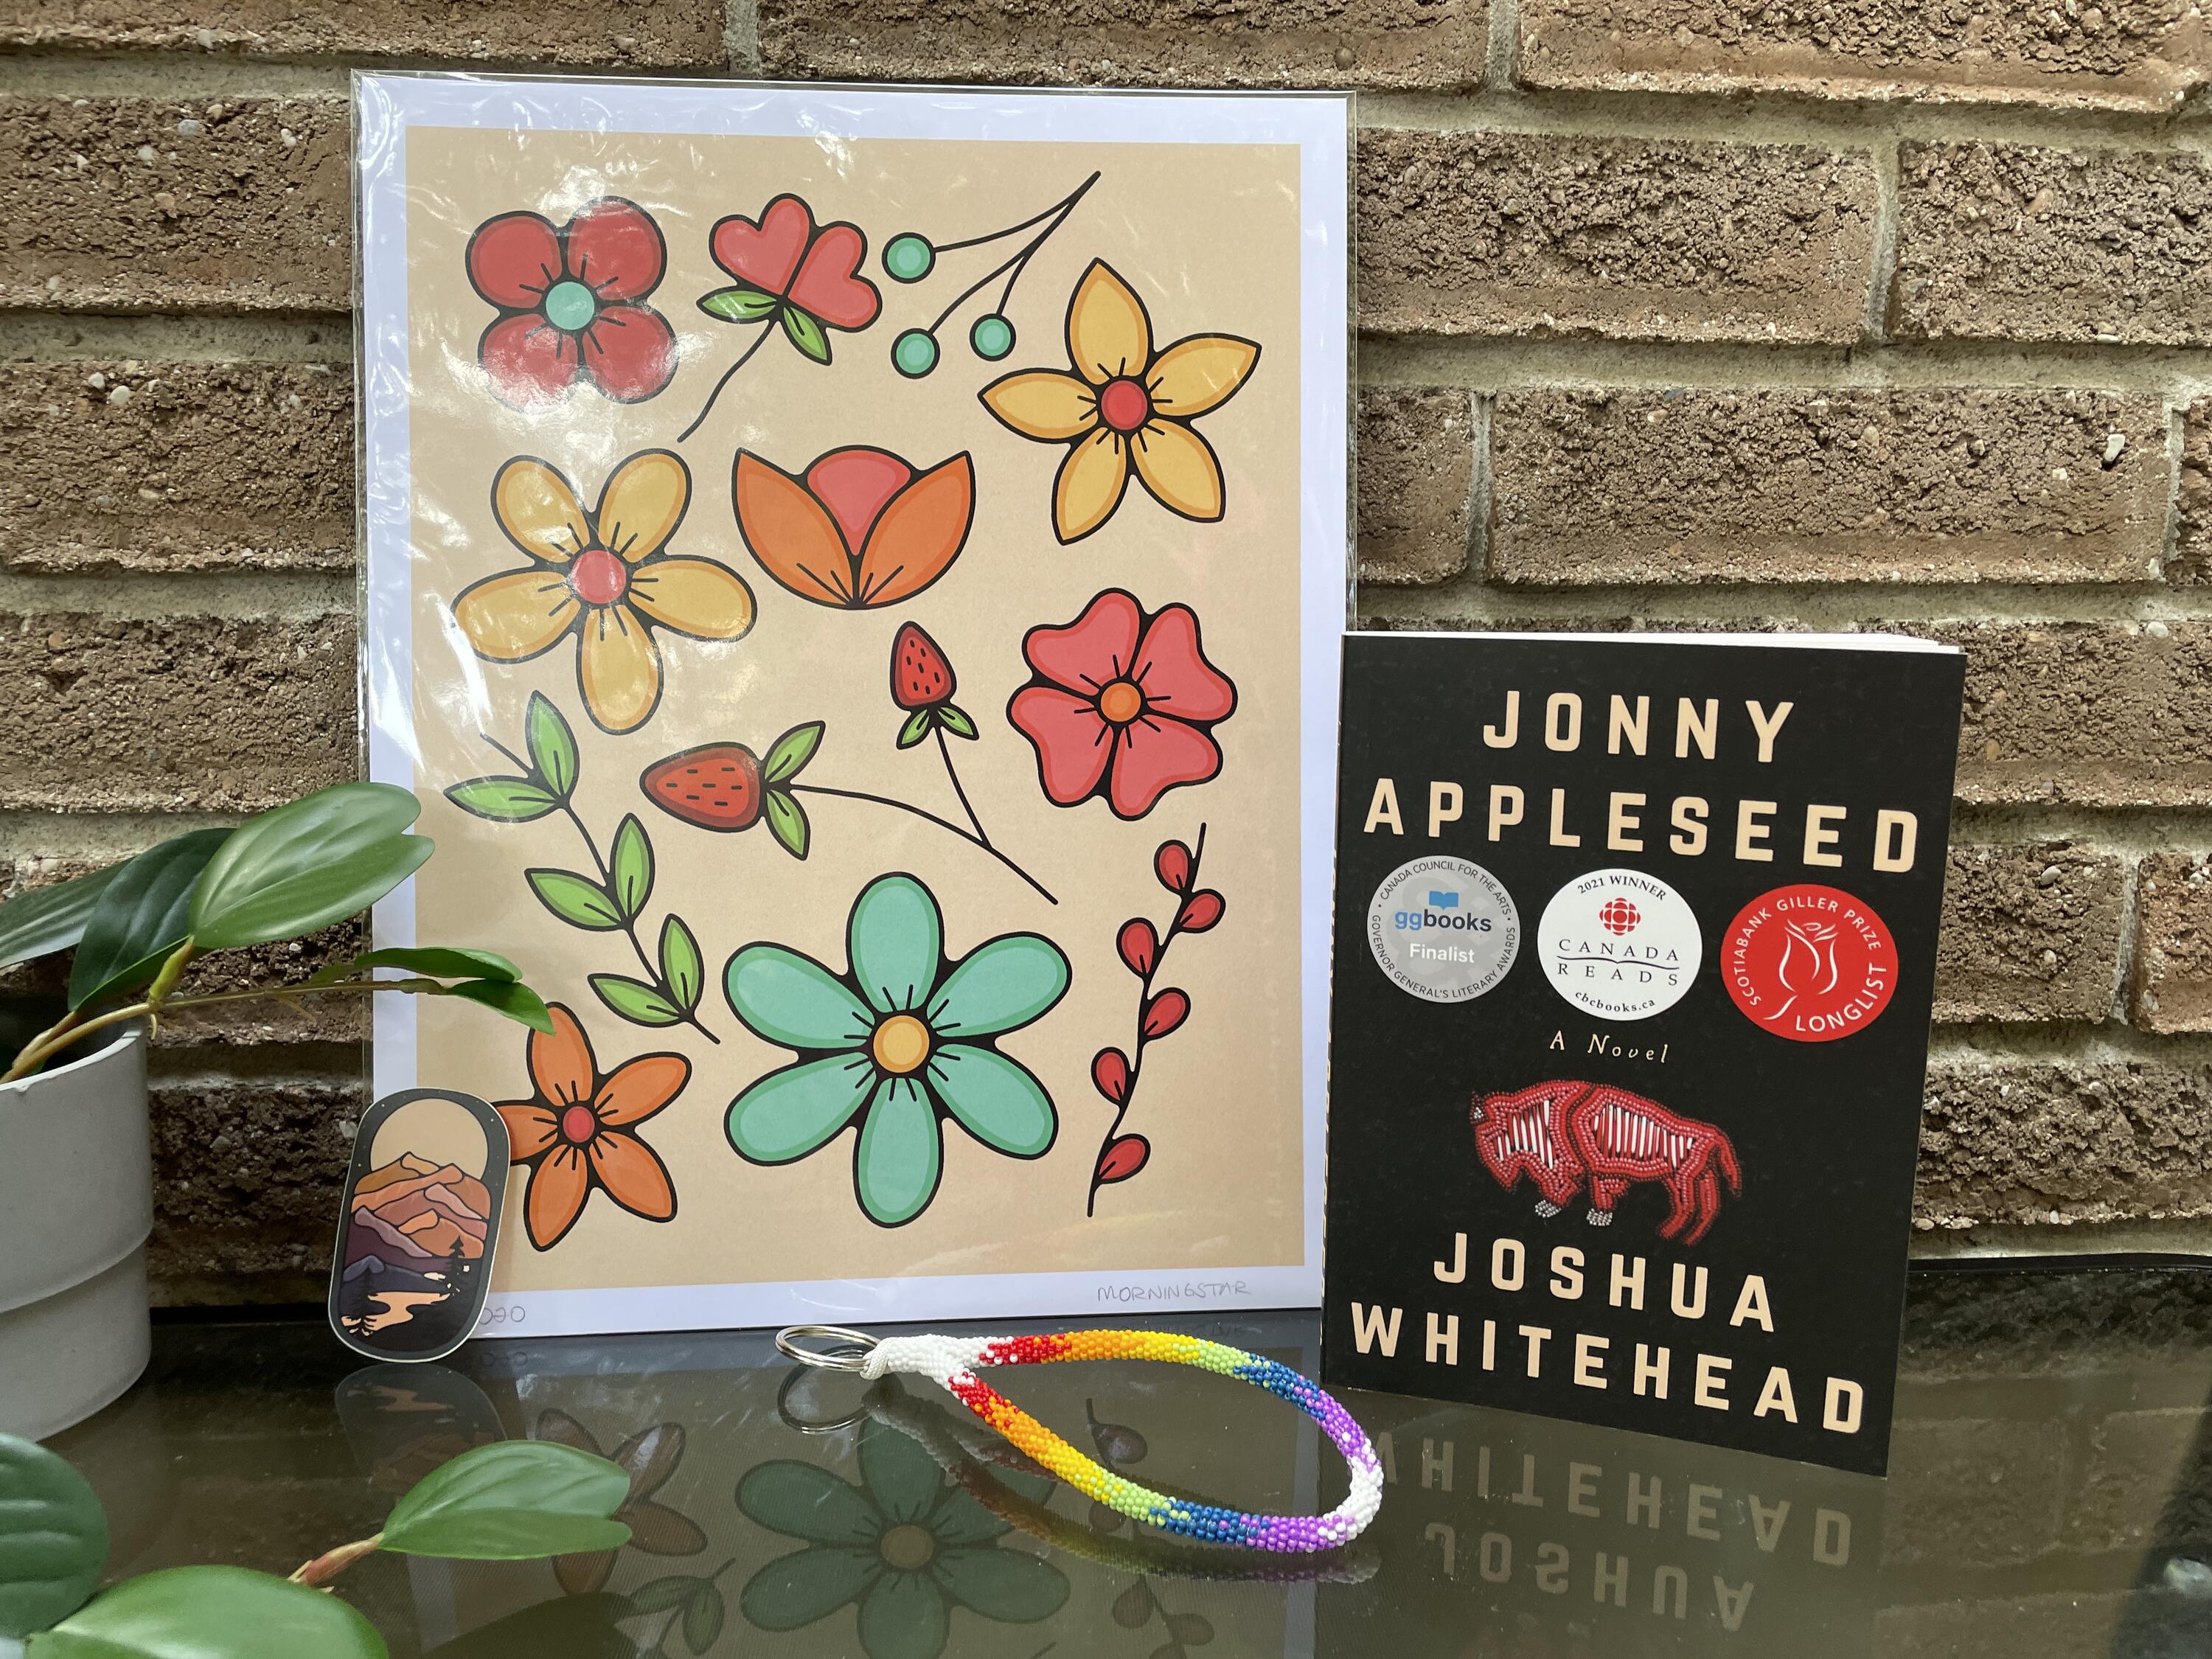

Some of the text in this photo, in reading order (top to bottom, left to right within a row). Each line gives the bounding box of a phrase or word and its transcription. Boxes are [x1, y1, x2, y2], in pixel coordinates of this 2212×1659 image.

[1483, 690, 1794, 763] JONNY
[1363, 777, 1918, 873] APPLESEED
[1380, 860, 1512, 916] CANADA COUNCIL FOR THE ARTS
[1577, 875, 1667, 901] 2021 WINNER
[1394, 908, 1492, 932] ggbooks
[1371, 914, 1515, 998] GOVERNOR GENERAL'S LITERARY AWARDS
[1409, 942, 1475, 964] Finalist
[1559, 939, 1679, 961] CANADA
[1733, 896, 1882, 1006] SCOTIABANK GILLER PRIZE
[1557, 962, 1678, 986] READS
[1575, 991, 1655, 1012] cbcbooks.ca
[1795, 961, 1888, 1032] LONGLIST
[1549, 1030, 1669, 1063] A Novel
[1097, 1281, 1251, 1302] MORNINGSTAR
[1433, 1232, 1775, 1332] JOSHUA
[1351, 1301, 1864, 1434] WHITEHEAD
